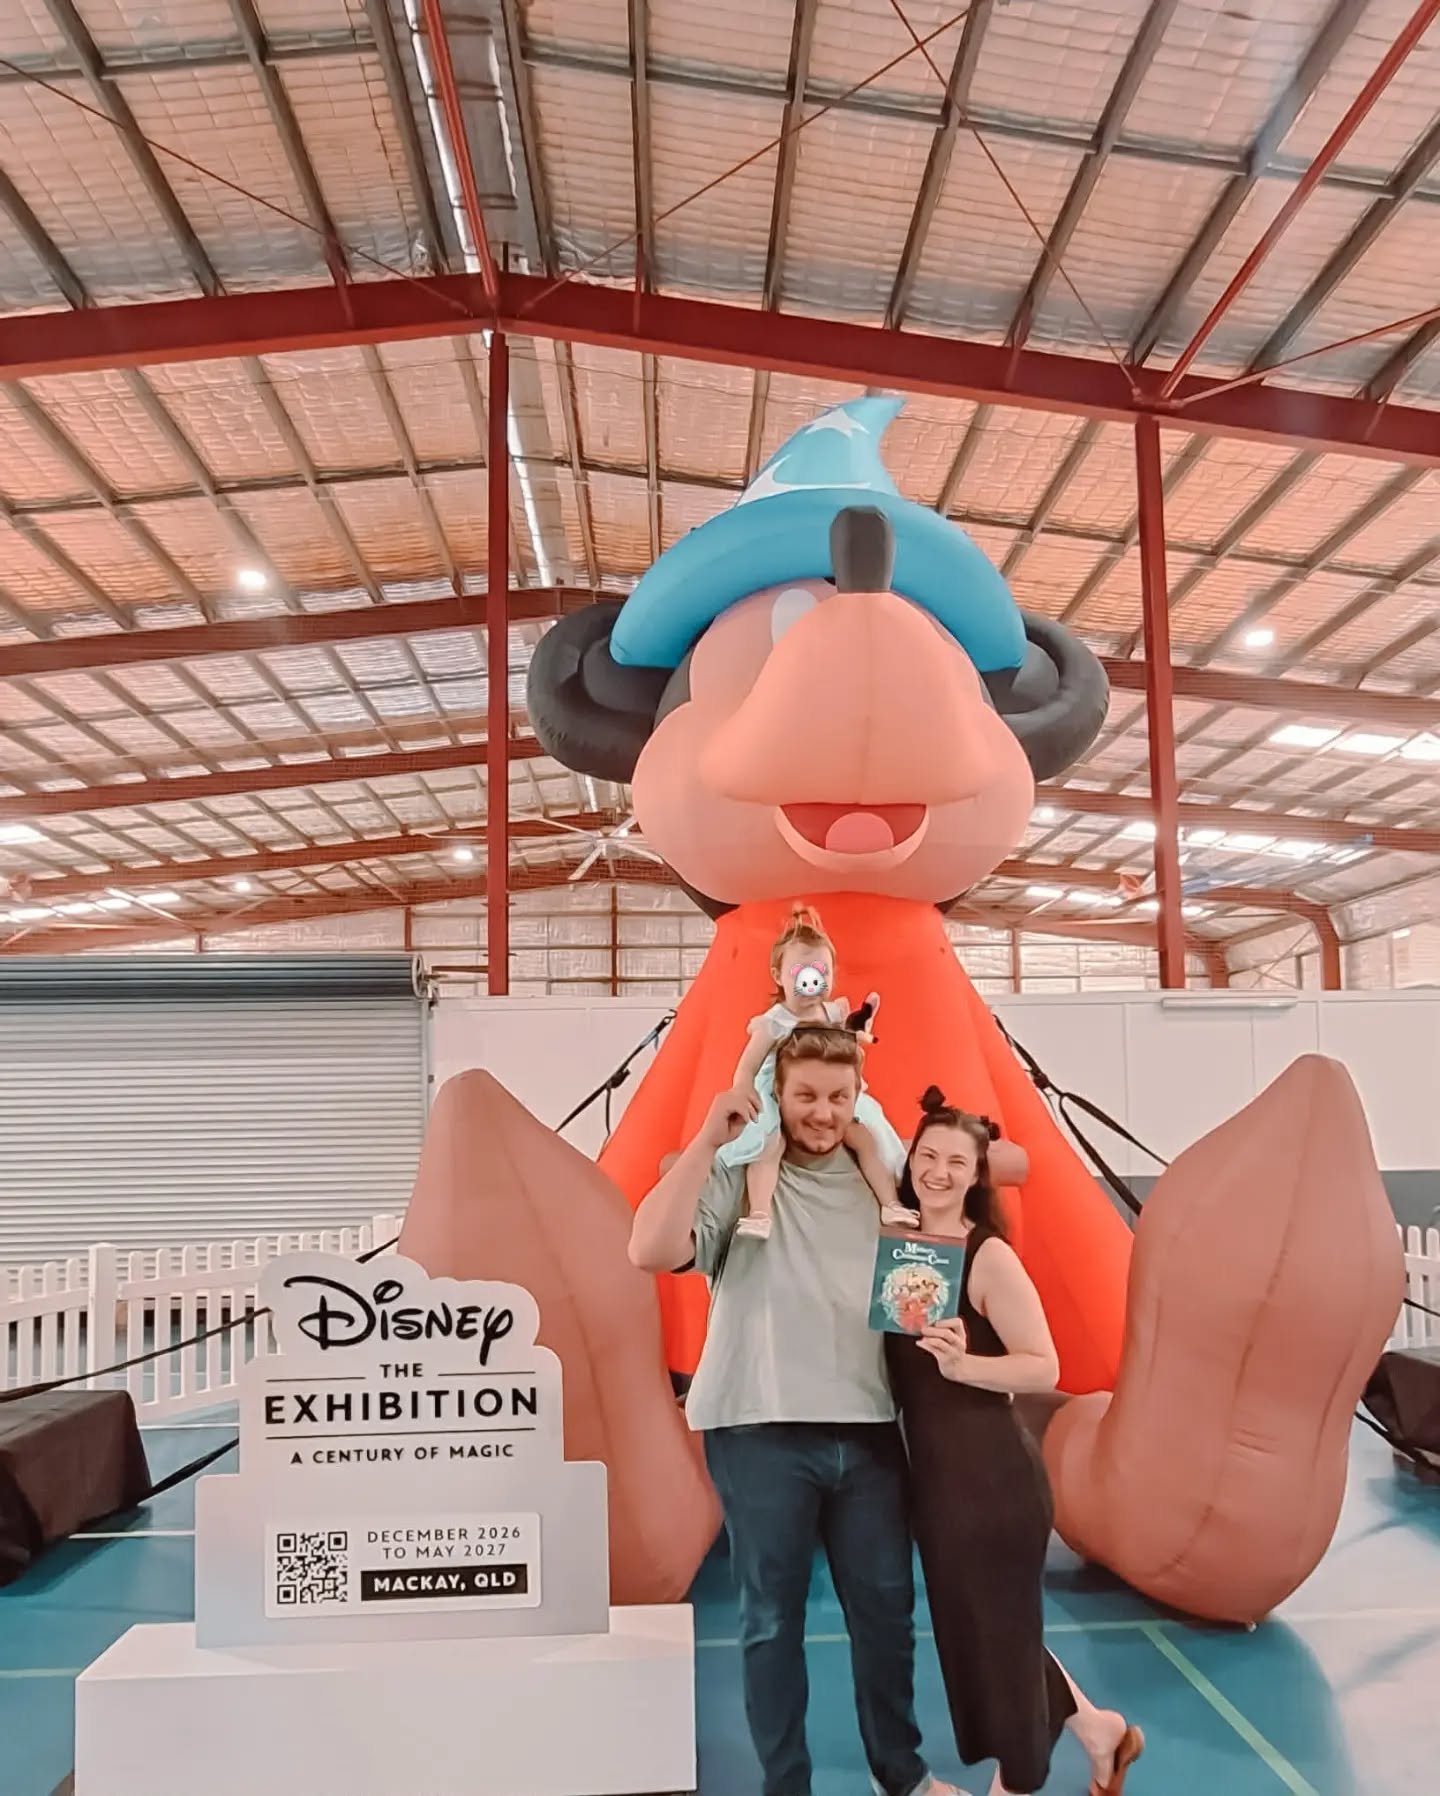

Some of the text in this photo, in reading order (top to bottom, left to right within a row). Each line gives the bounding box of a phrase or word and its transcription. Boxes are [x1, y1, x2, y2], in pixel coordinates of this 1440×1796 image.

[379, 1363, 424, 1379] THE
[264, 1387, 538, 1425] EXHIBITION
[290, 1443, 515, 1465] A CENTURY OF MAGIC
[367, 1526, 521, 1544] DECEMBER 2026
[382, 1543, 506, 1560] TO MAY 2027
[374, 1573, 517, 1593] MACKAY, QLD
